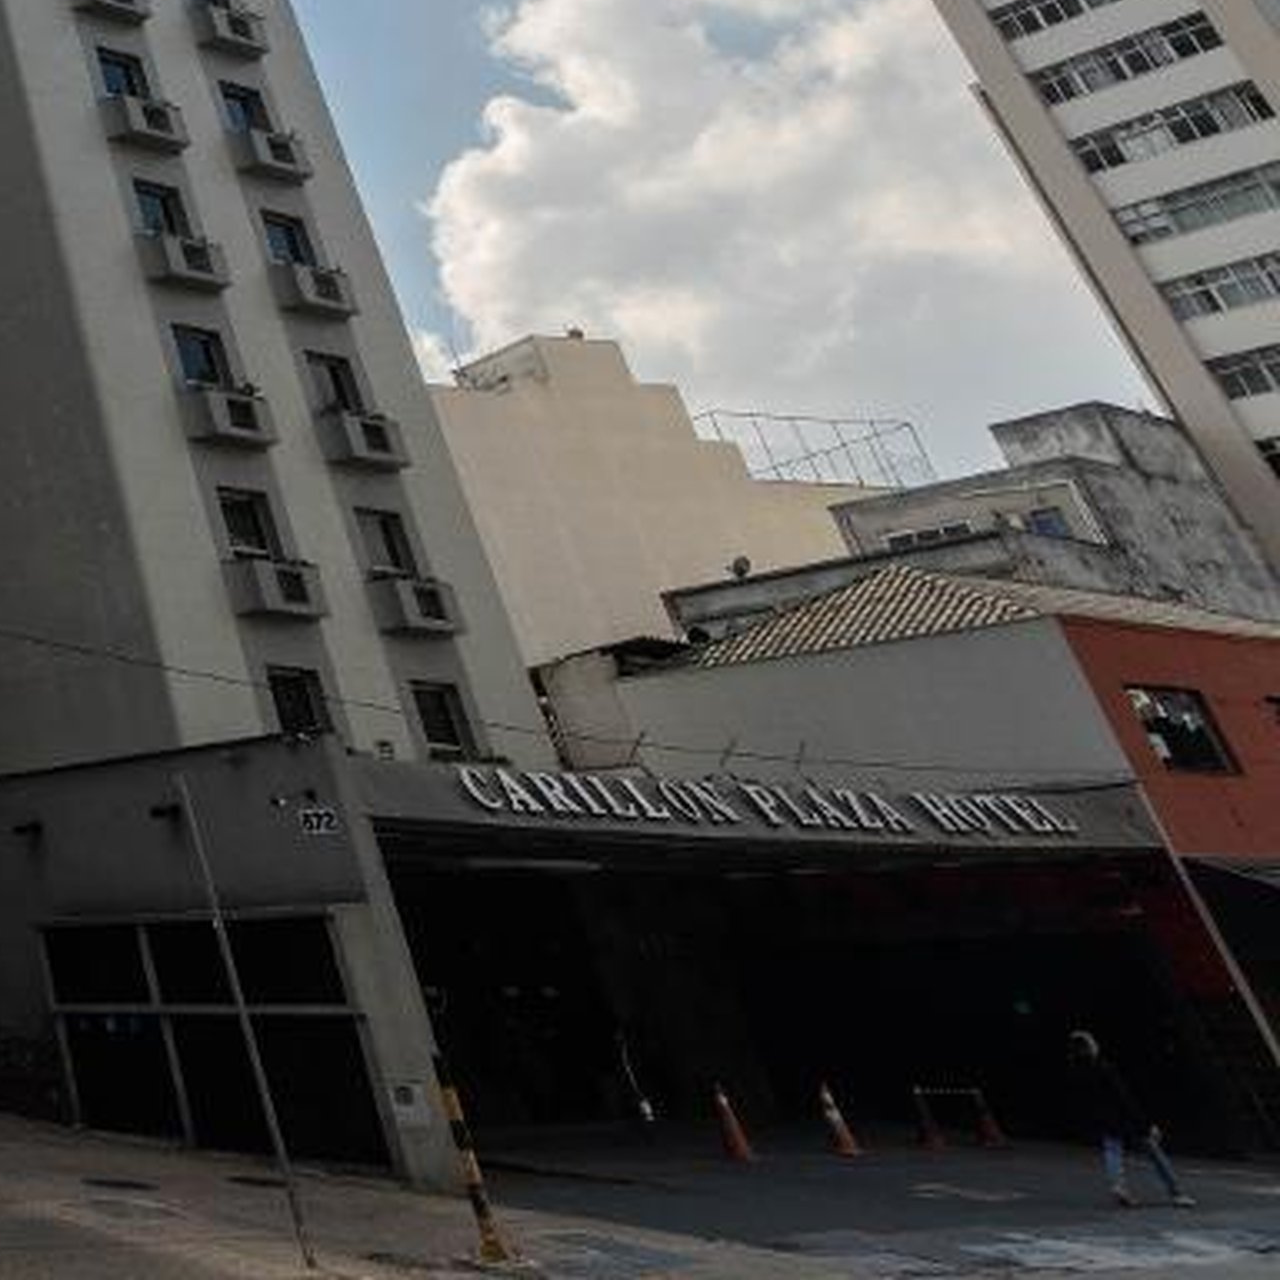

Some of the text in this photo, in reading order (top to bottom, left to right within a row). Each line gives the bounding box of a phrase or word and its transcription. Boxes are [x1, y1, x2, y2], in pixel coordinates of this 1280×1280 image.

[456, 767, 1080, 832] CARILLON PLAZA HOTEL
